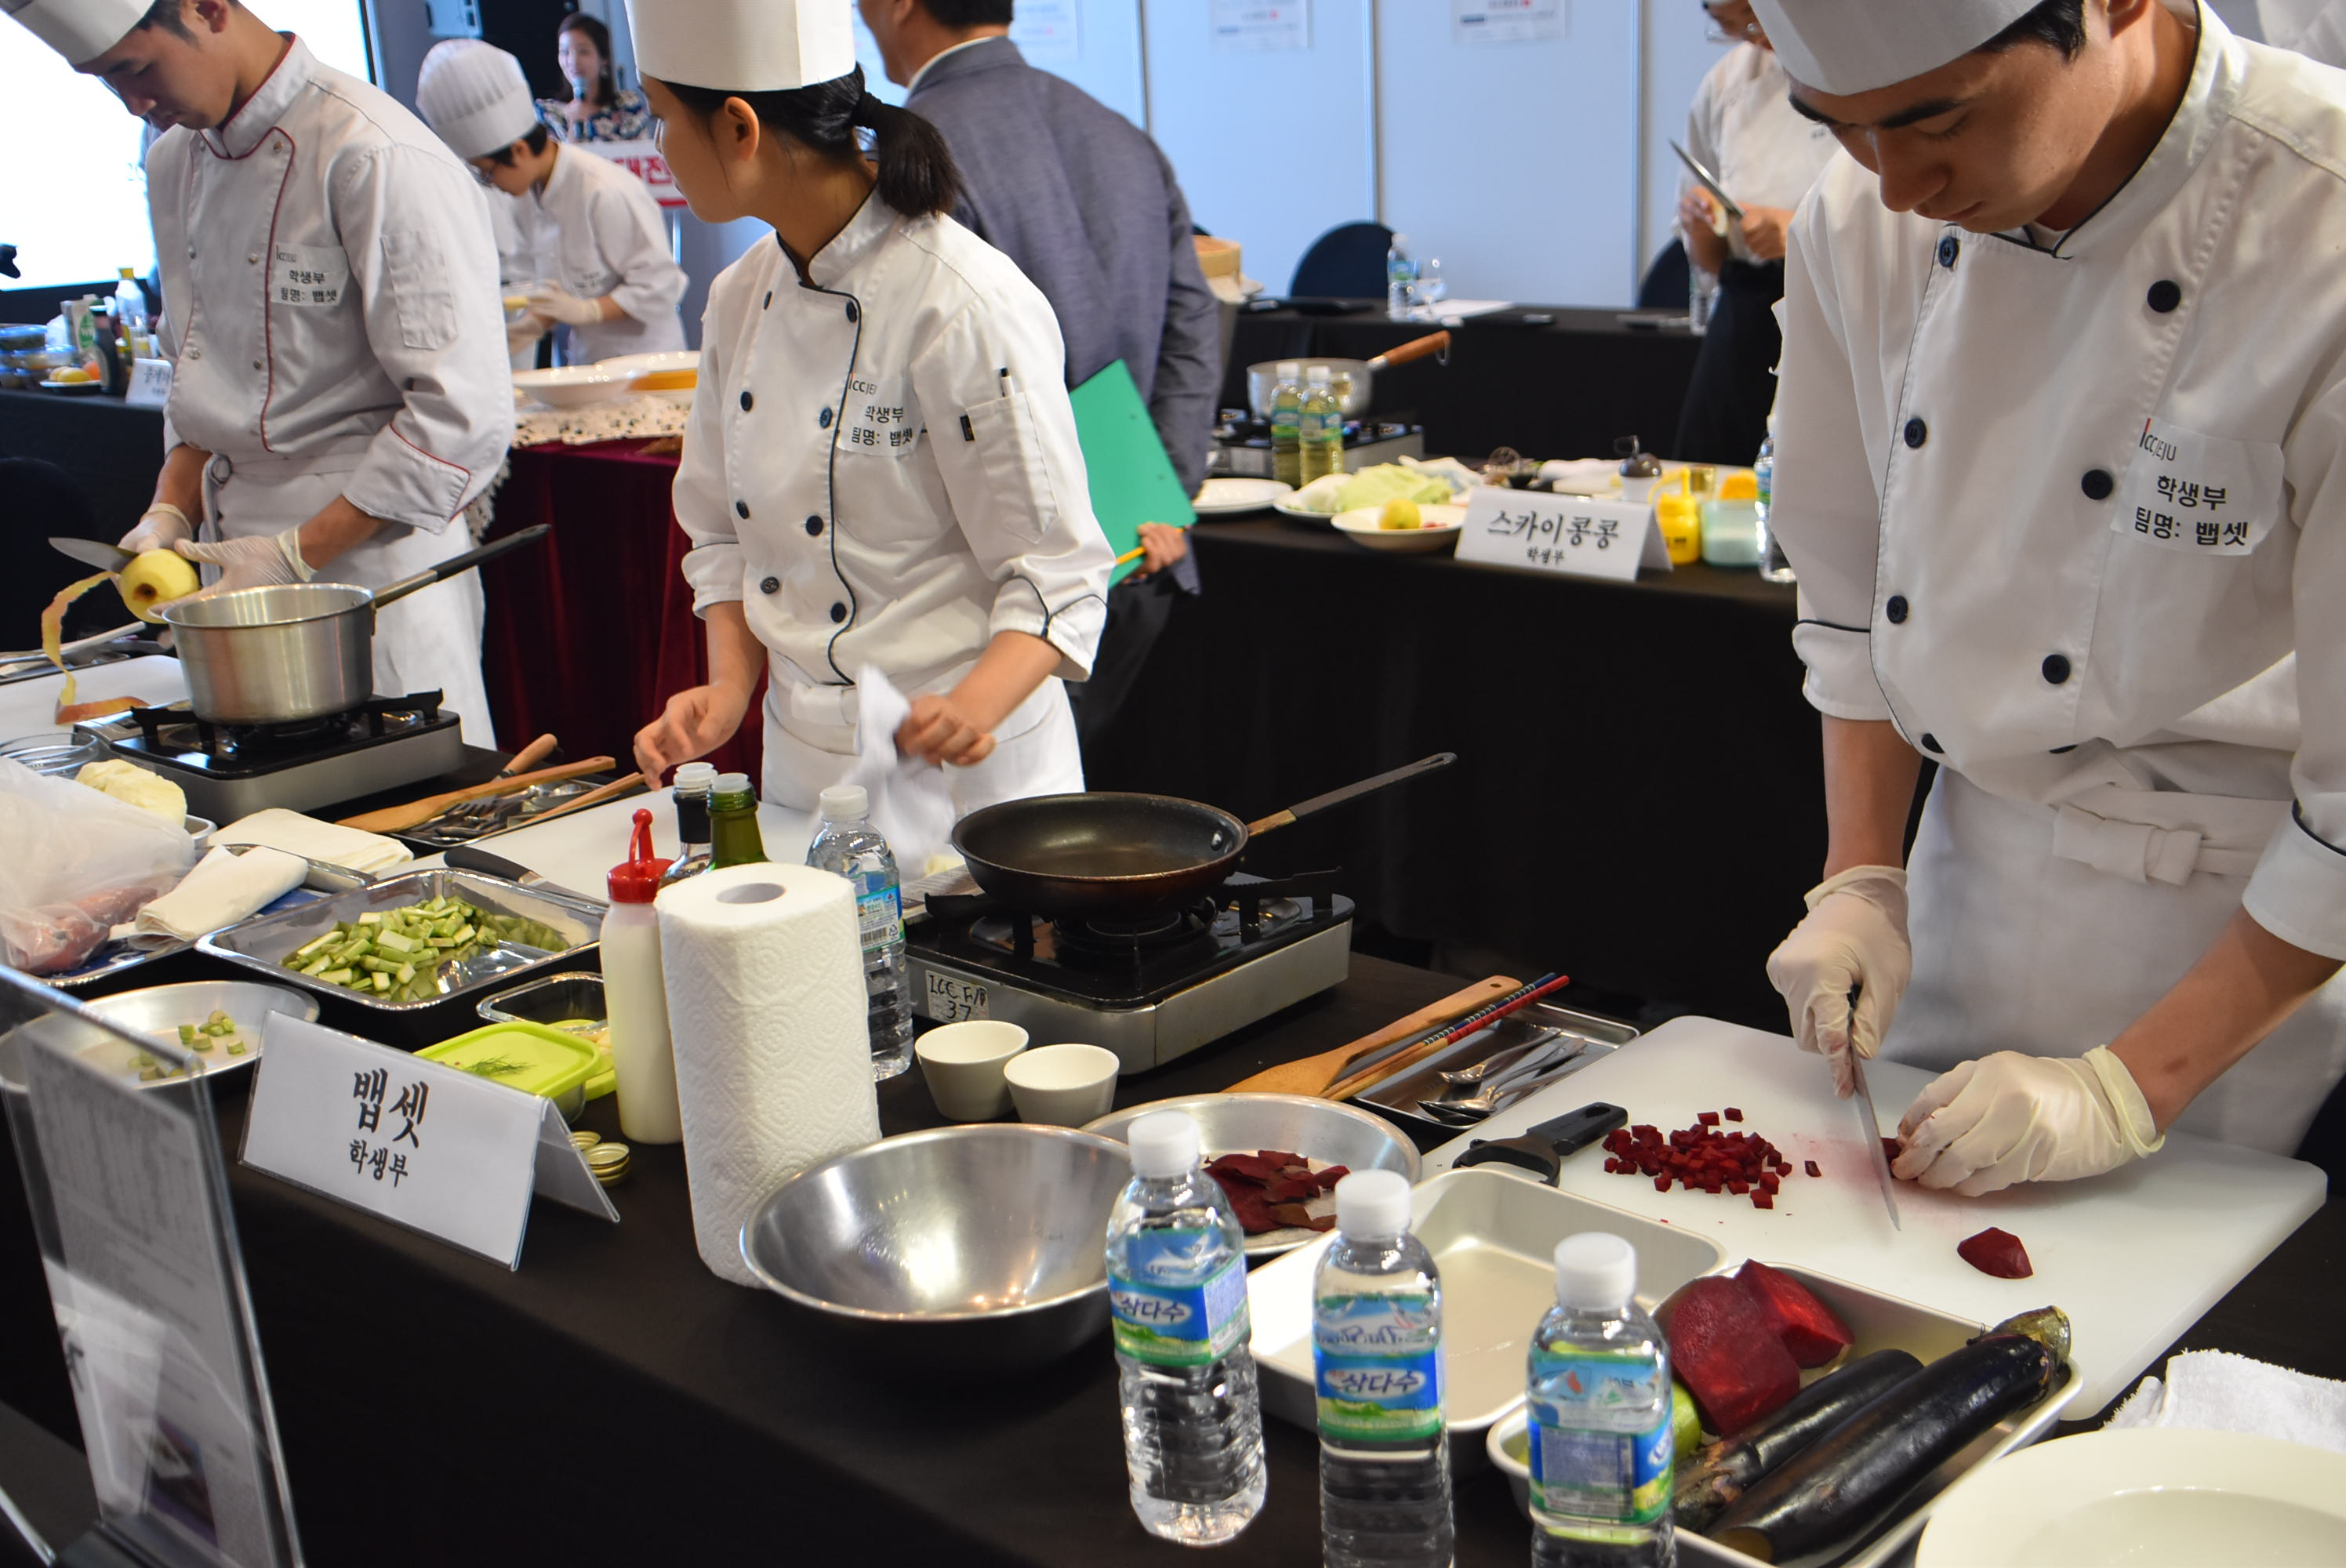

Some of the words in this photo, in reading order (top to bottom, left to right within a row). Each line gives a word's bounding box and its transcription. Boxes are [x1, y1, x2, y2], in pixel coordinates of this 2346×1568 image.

[289, 270, 325, 285] 학생부
[865, 405, 903, 423] 학생부
[852, 426, 880, 446] 팀명:
[890, 427, 913, 447] 뱁셋
[2157, 475, 2227, 511] 학생부
[1487, 510, 1618, 550] 스카이콩콩
[2134, 506, 2181, 540] 팀명:
[2195, 521, 2249, 546] 뱁셋
[1526, 546, 1566, 565] 학생부
[946, 1000, 971, 1022] 37
[352, 1067, 430, 1149] 뱁셋
[348, 1139, 409, 1188] 학생부
